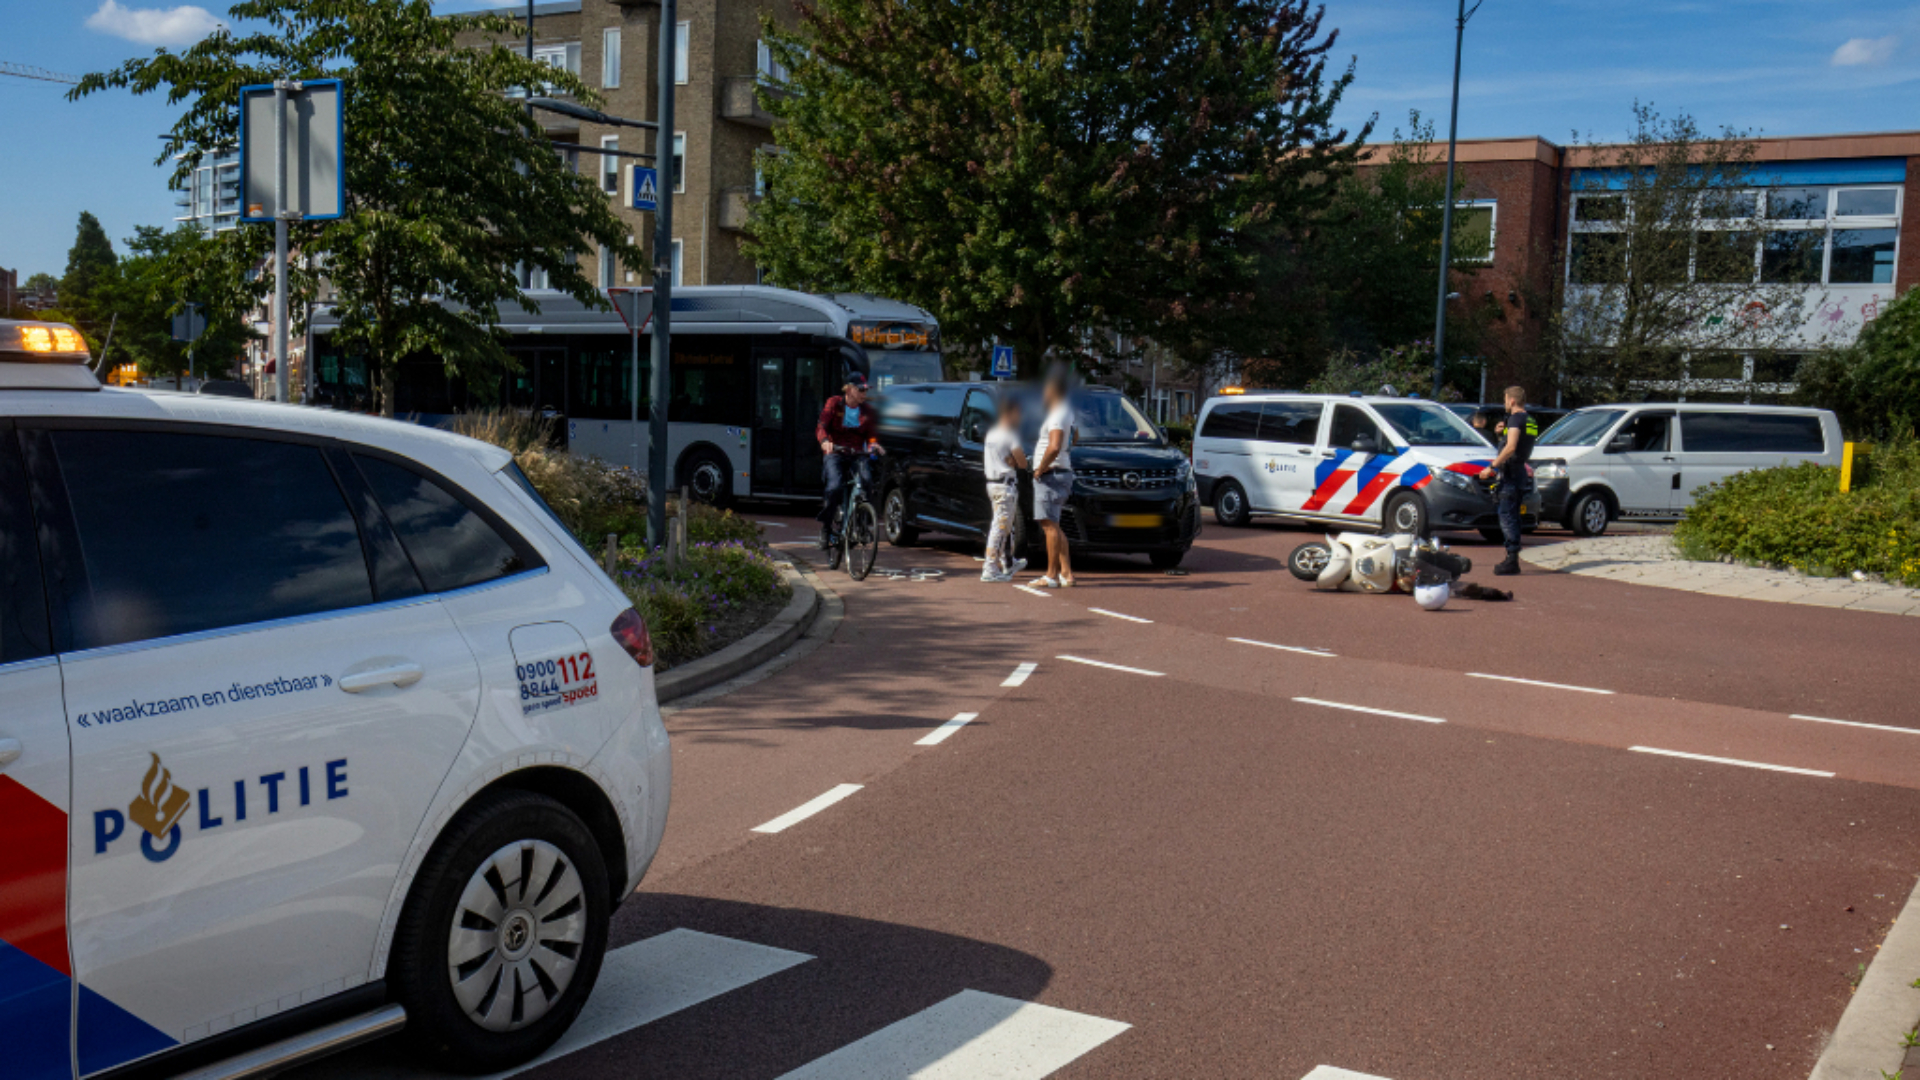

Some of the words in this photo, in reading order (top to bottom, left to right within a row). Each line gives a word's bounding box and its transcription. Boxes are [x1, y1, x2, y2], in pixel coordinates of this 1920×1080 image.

[516, 660, 556, 682] 0900
[557, 652, 595, 684] 112
[93, 695, 200, 726] waakzaam
[202, 690, 226, 707] en
[228, 674, 318, 703] dienstbaar
[520, 678, 559, 700] 8844
[562, 680, 597, 706] spoed
[94, 758, 349, 864] POLITIE
